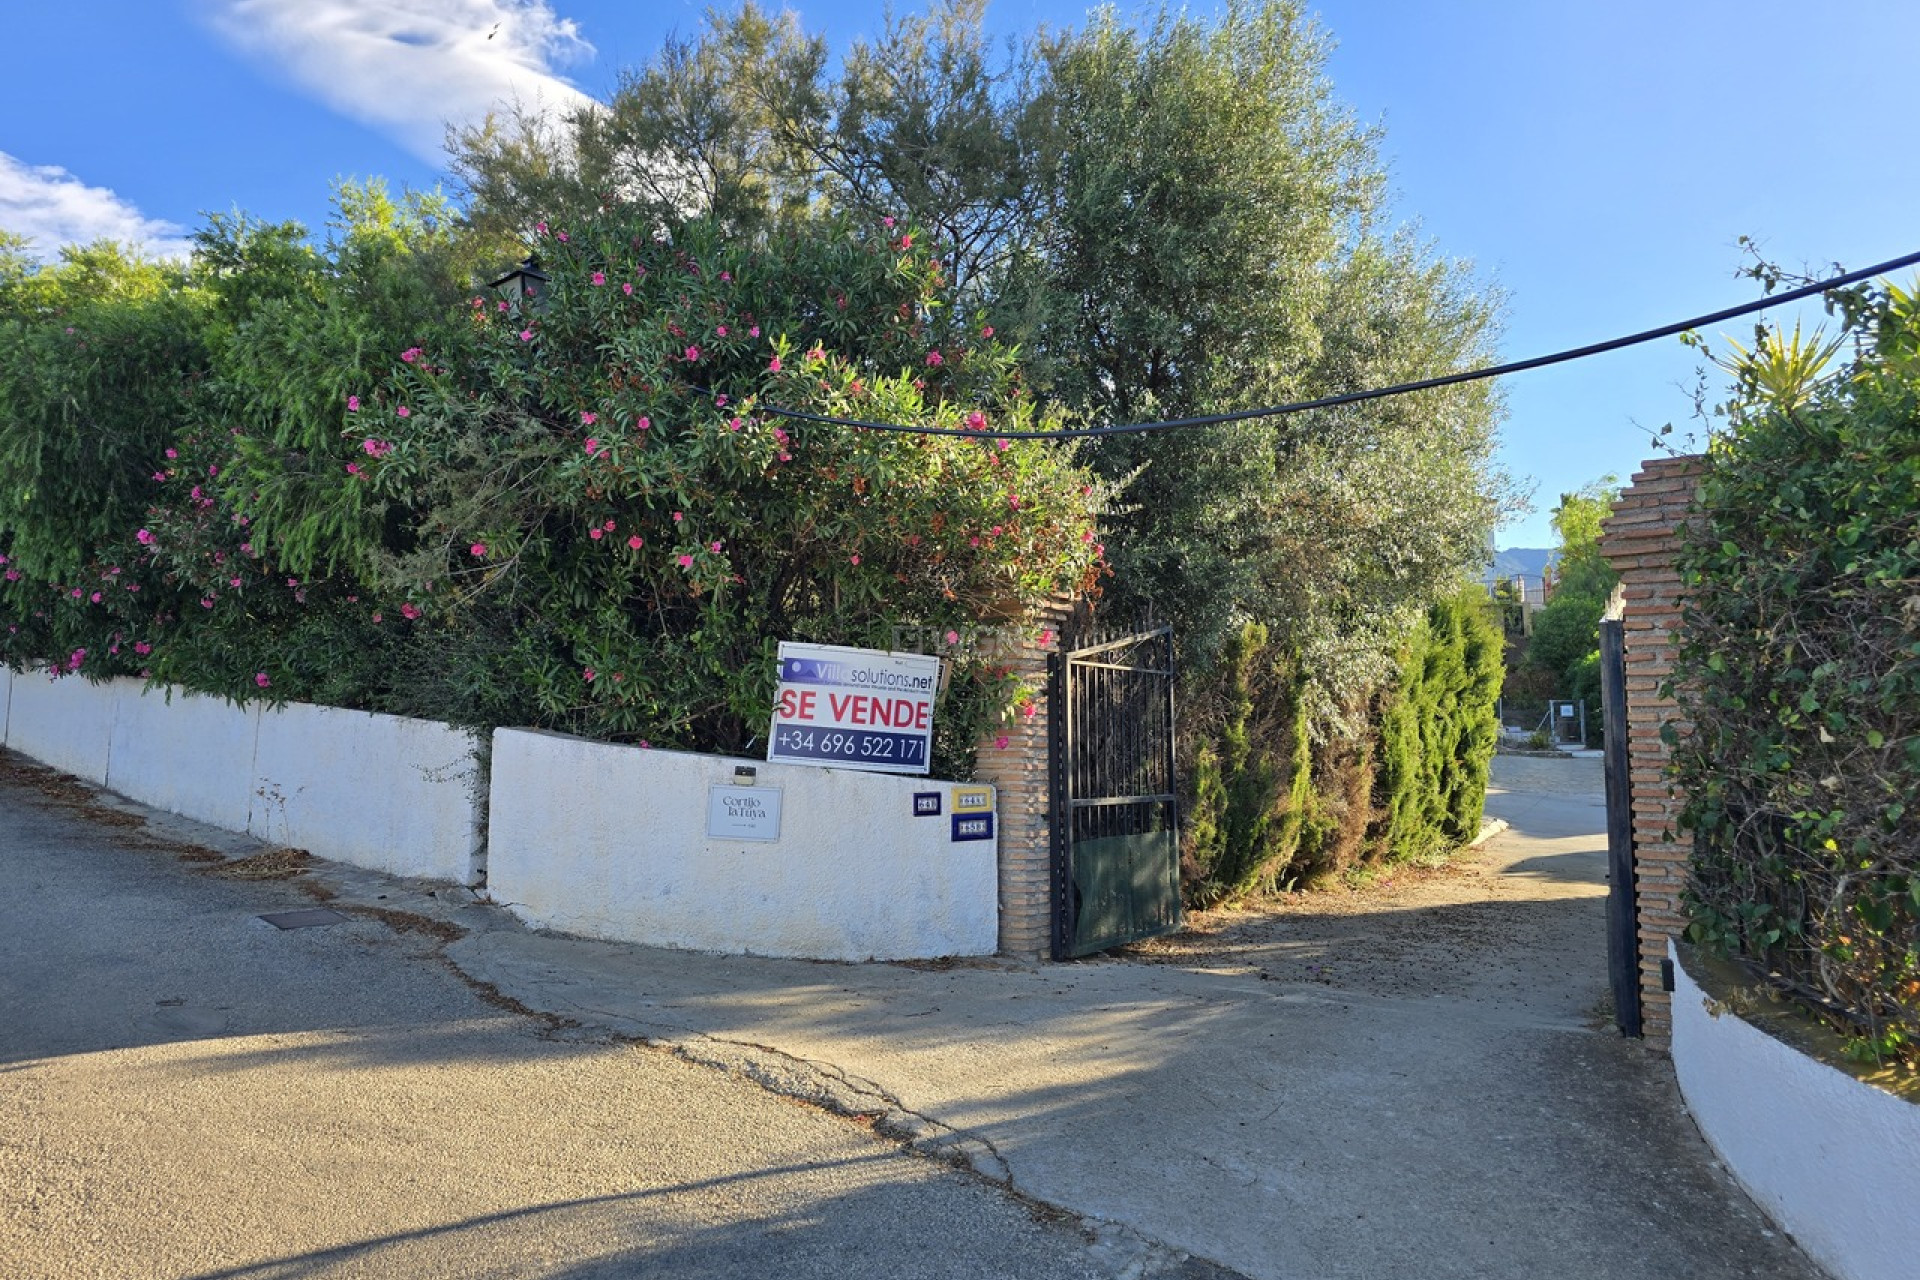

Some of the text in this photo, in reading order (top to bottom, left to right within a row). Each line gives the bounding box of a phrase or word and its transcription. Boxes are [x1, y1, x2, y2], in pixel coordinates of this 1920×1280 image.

[779, 689, 930, 730] SE VENDE
[778, 730, 925, 760] +34 696 522 171
